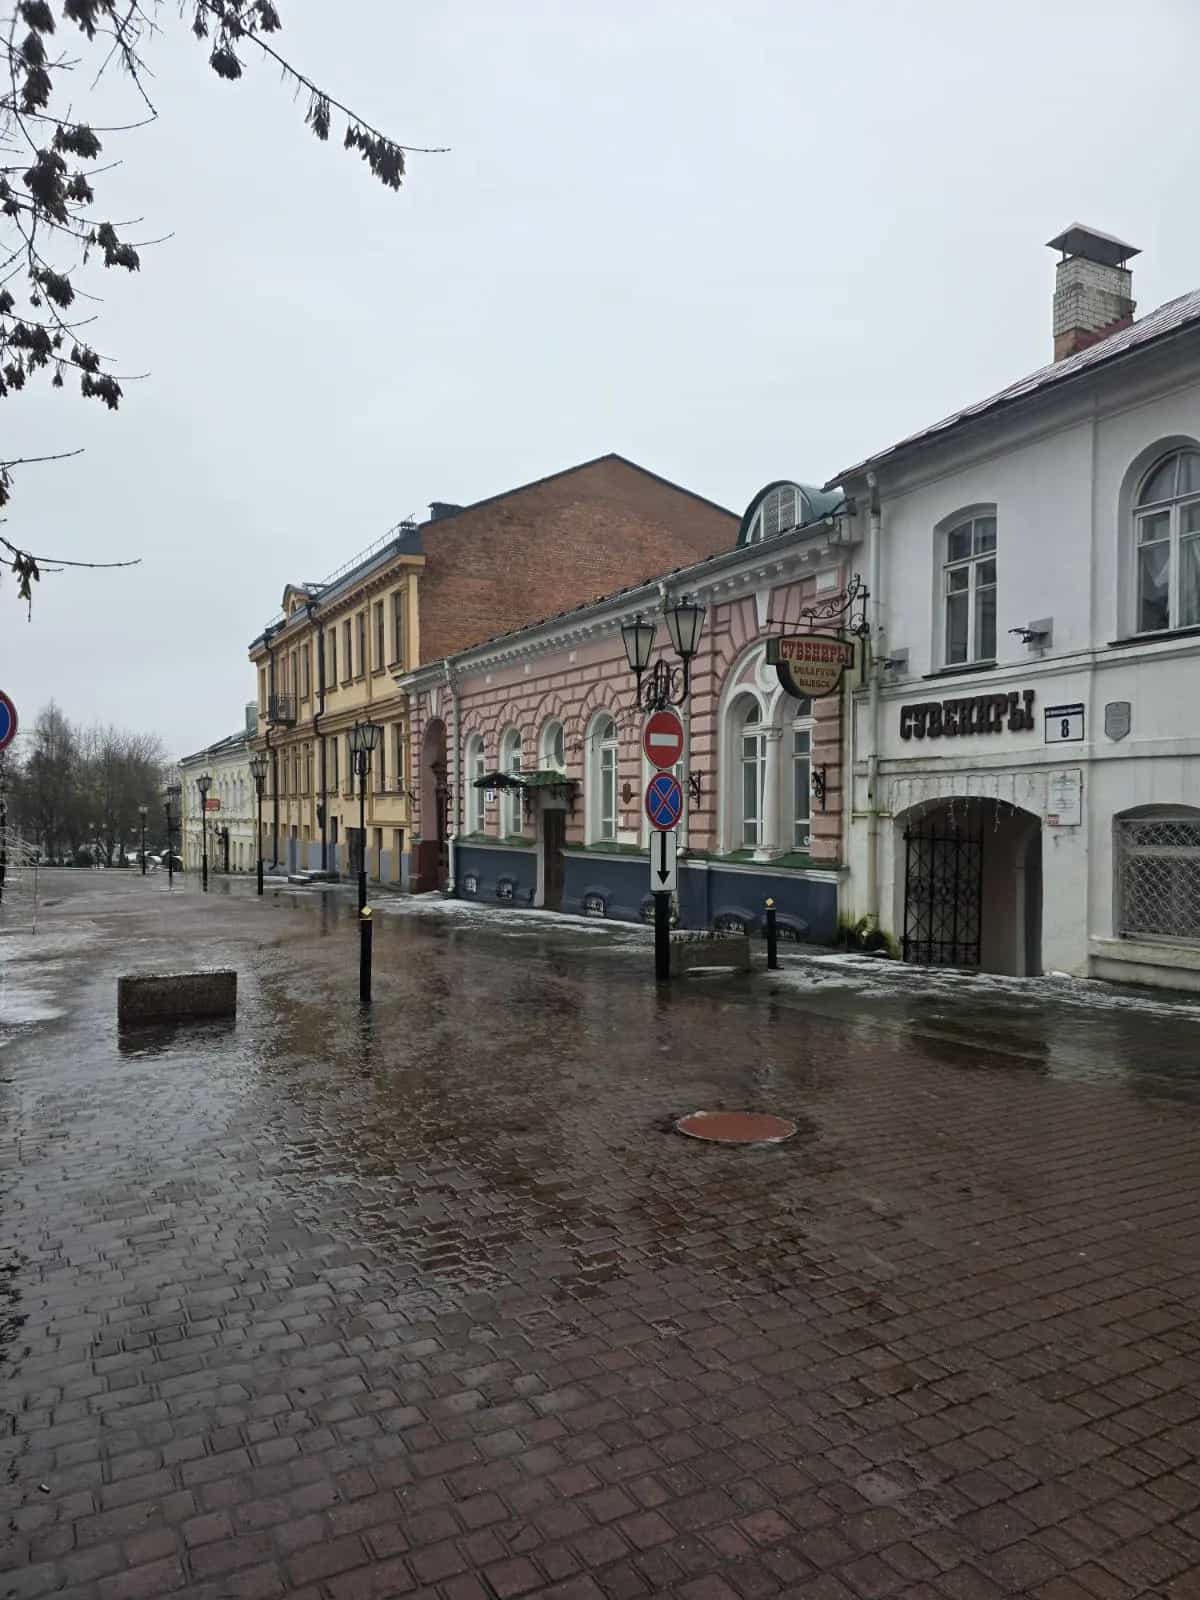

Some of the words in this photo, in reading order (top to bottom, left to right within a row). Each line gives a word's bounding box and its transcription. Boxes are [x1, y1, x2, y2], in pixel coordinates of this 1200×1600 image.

[781, 639, 849, 664] СУВЕНИРЫ
[900, 690, 1034, 739] СУВЕНИРЫ
[1061, 718, 1069, 738] 8
